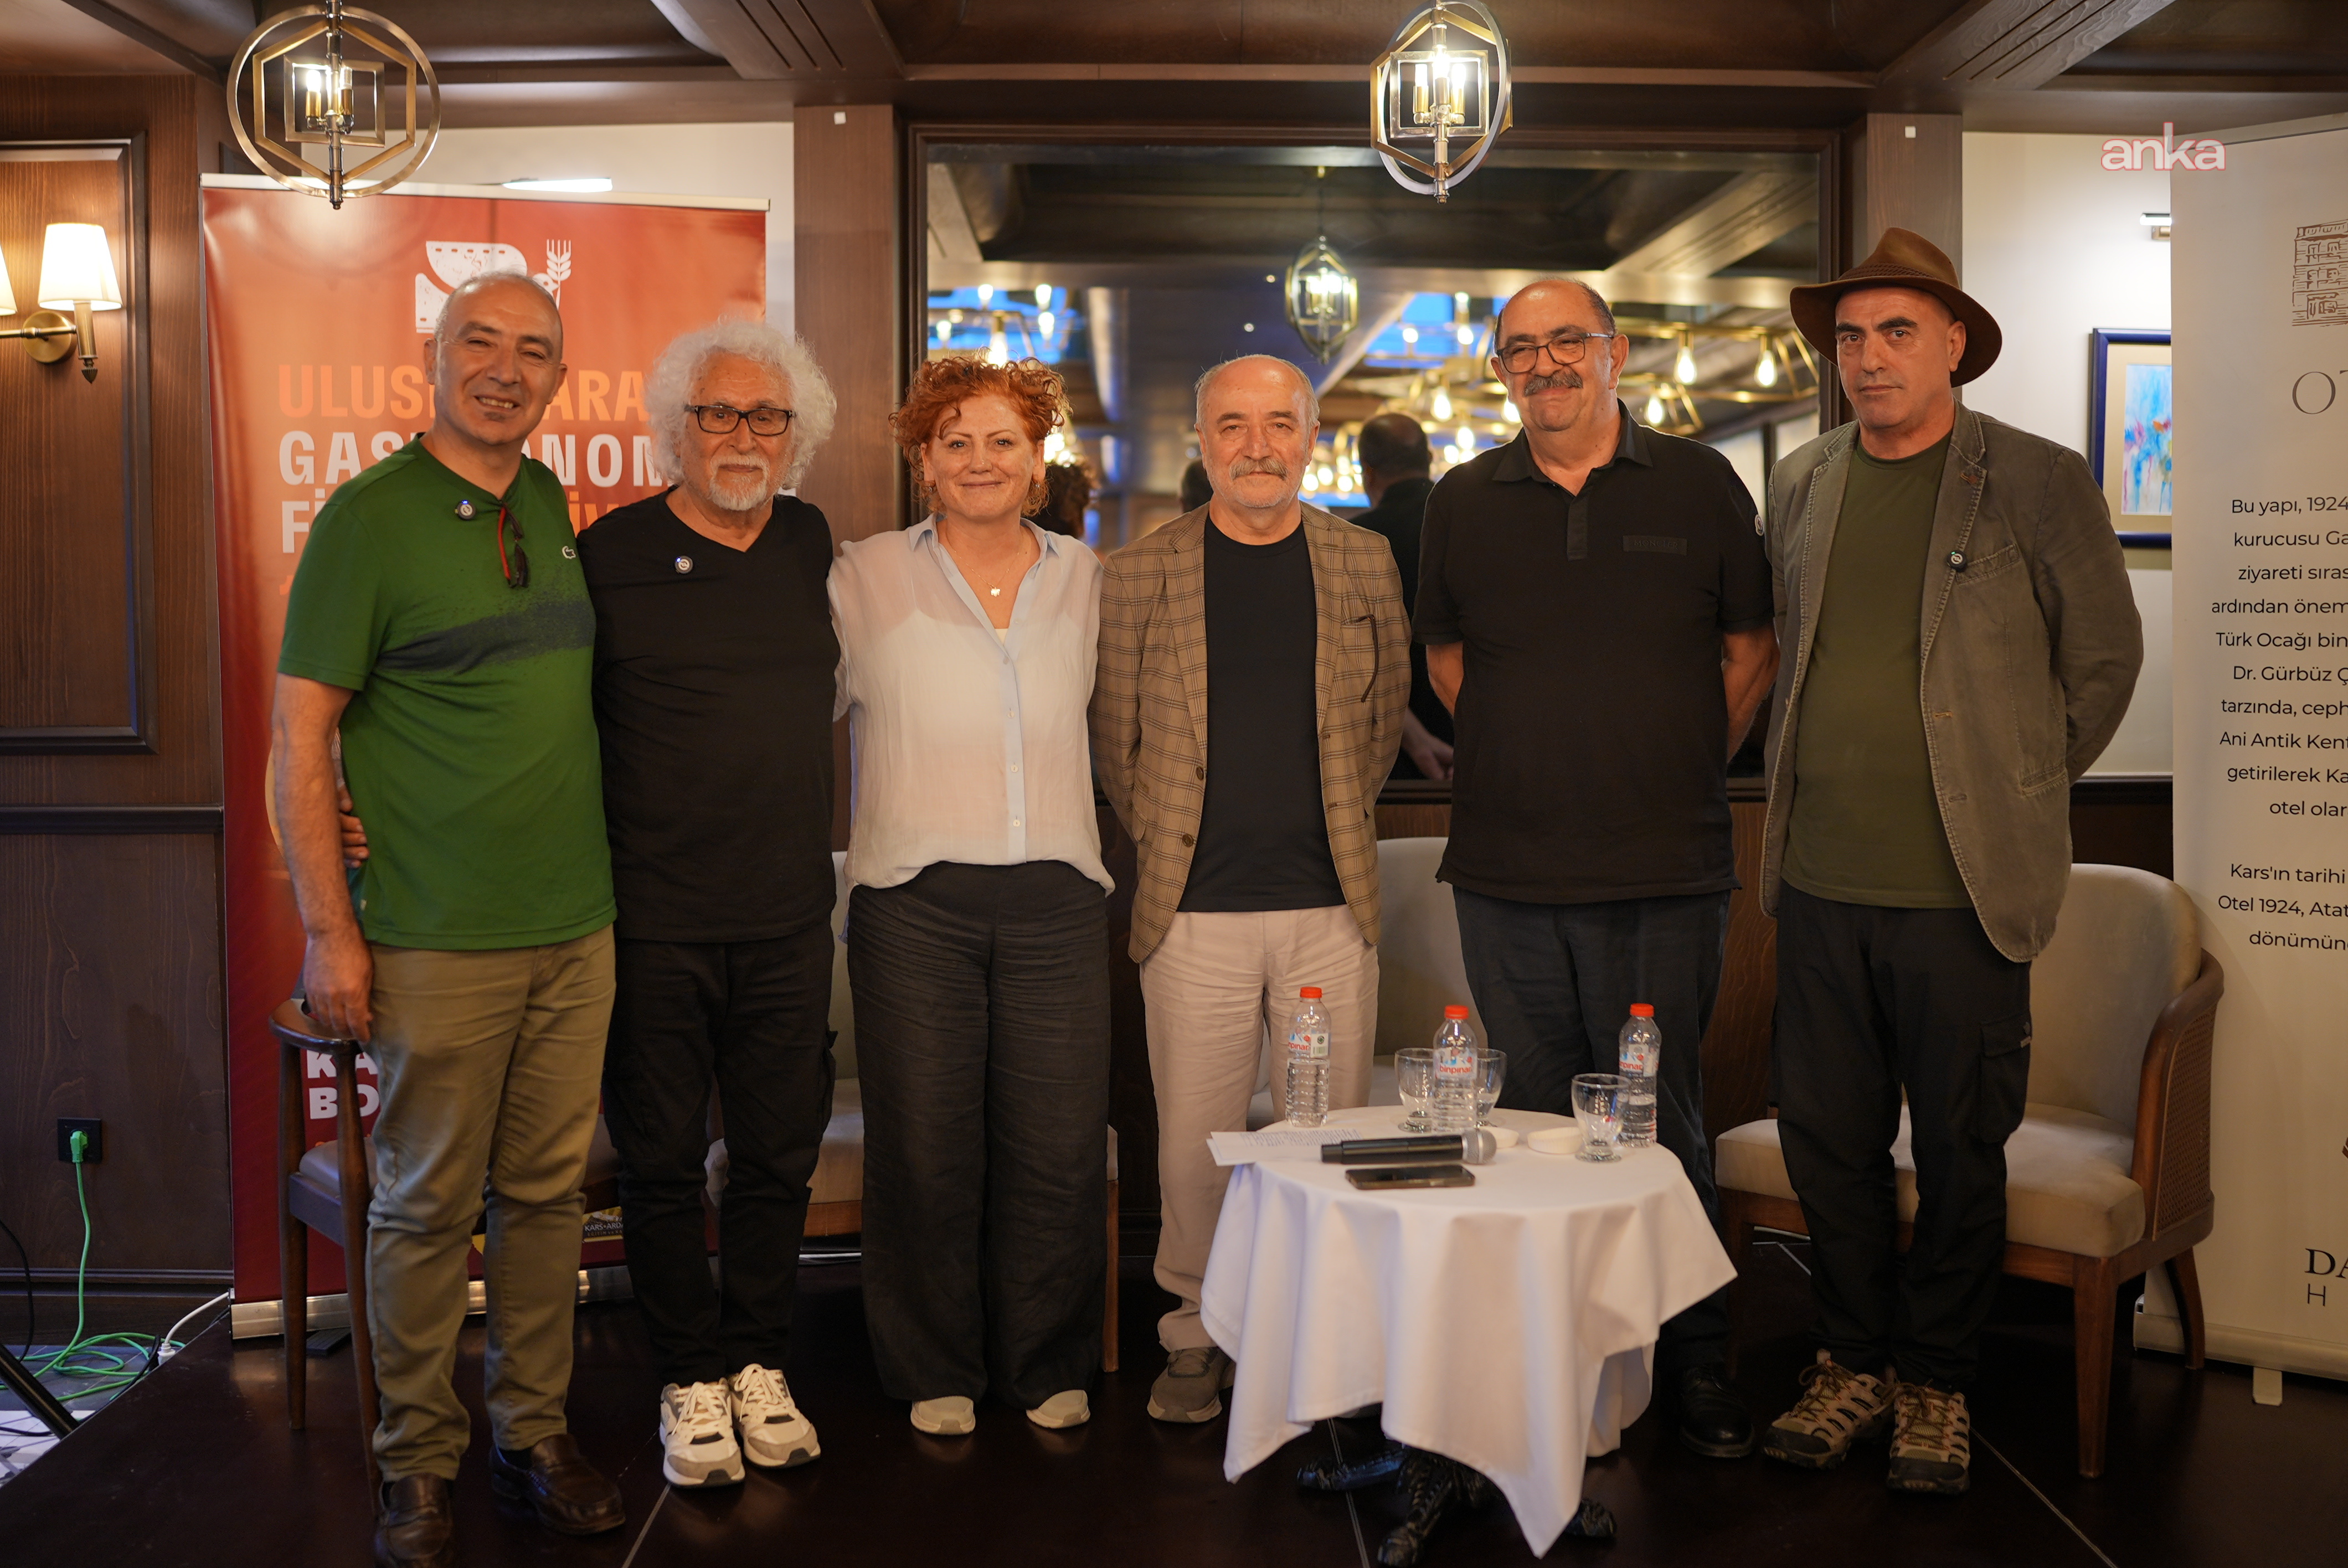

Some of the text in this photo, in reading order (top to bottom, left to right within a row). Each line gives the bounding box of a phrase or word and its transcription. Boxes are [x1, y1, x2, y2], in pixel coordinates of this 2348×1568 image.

[2292, 370, 2348, 414] O
[2232, 496, 2348, 516] Bu yapı, 1924
[2234, 532, 2320, 546] kurucusu
[2238, 565, 2302, 583] ziyareti
[2212, 599, 2288, 613] ardından
[2216, 632, 2348, 651] Türk Ocağı bin
[2234, 666, 2256, 680] Dr.
[2262, 666, 2332, 682] Gürbüz
[2221, 699, 2296, 717] tarzında,
[2220, 731, 2246, 746] Ani
[2251, 733, 2301, 748] Antik
[2227, 766, 2321, 782] getirilerek
[2270, 801, 2348, 817] otel olar
[2231, 864, 2345, 884] Kars'ın tarihi
[2218, 895, 2253, 911] Otel
[2259, 899, 2304, 917] 1924,
[2249, 931, 2348, 950] dönümün
